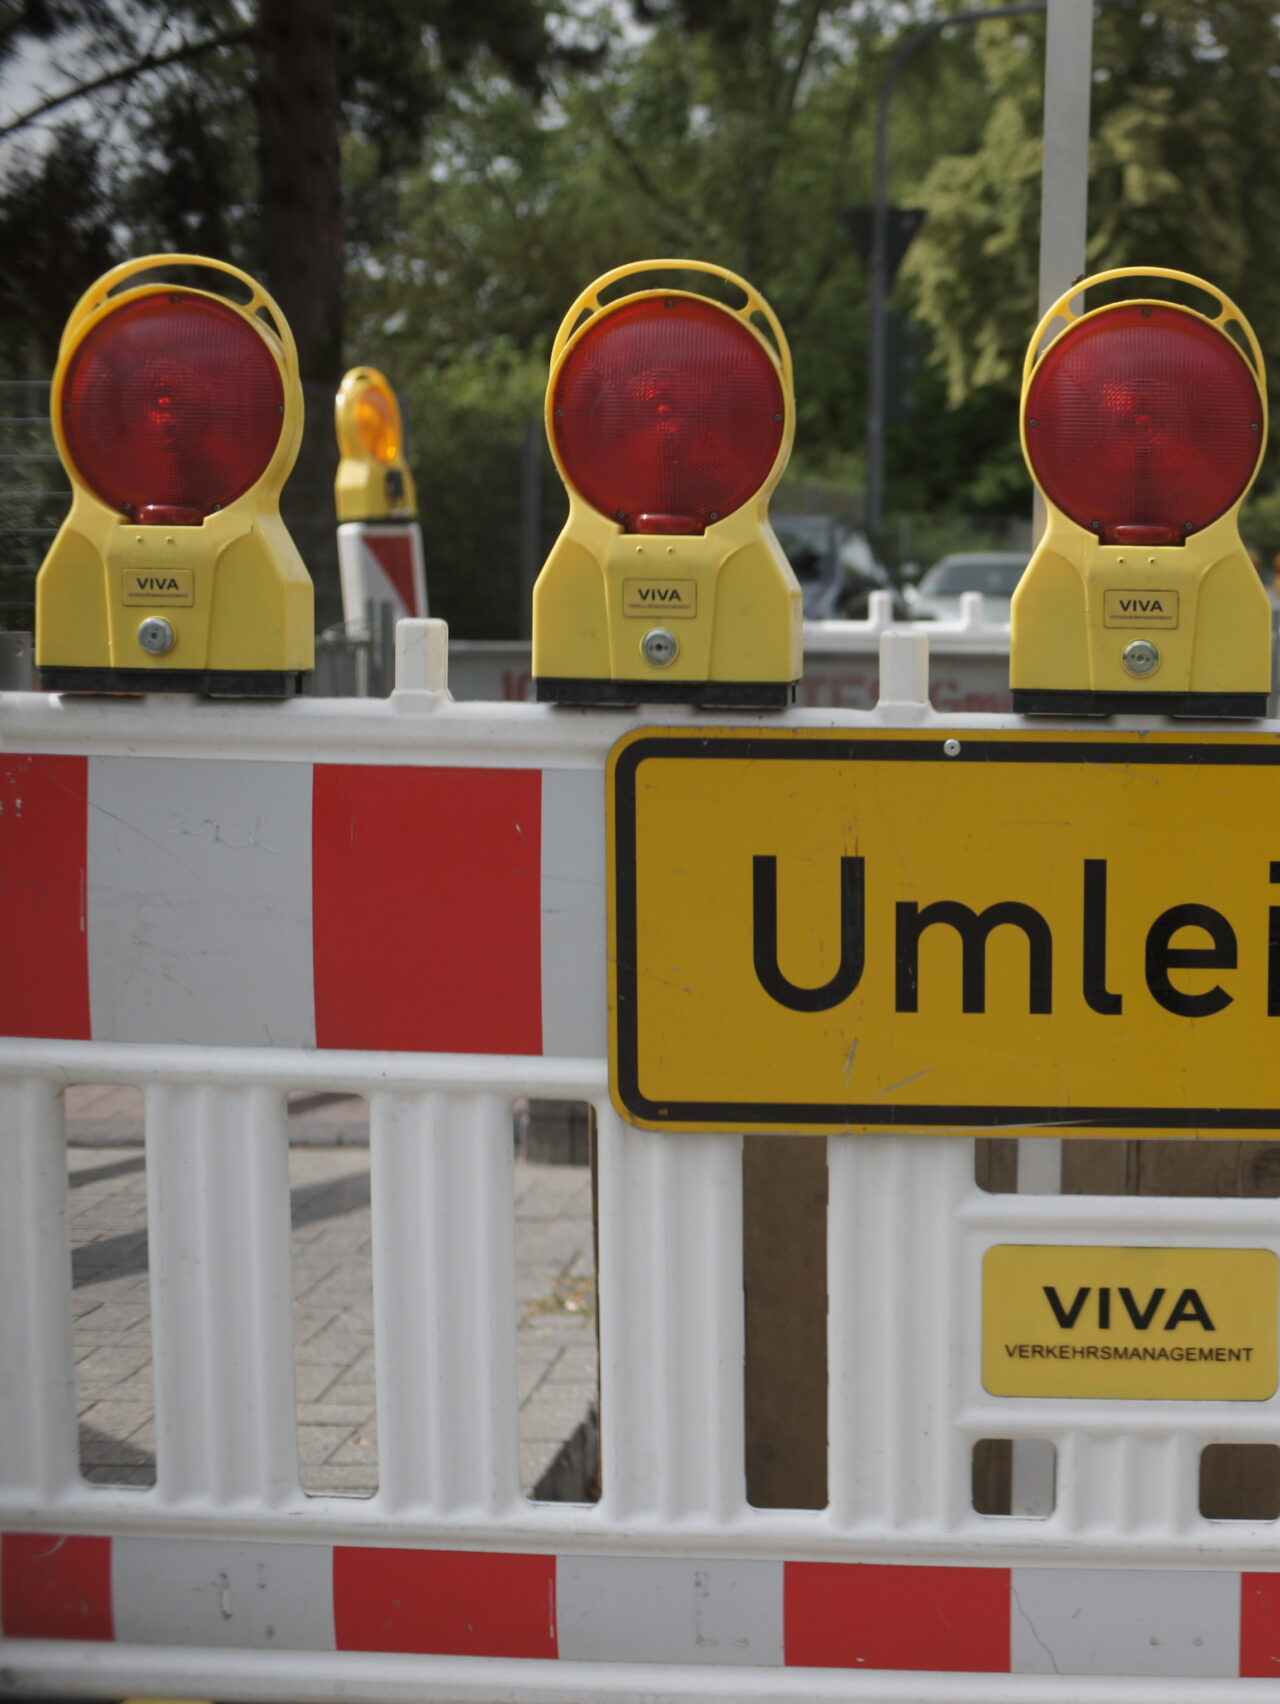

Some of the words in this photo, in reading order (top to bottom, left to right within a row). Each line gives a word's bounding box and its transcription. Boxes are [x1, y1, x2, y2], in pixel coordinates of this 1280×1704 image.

[136, 578, 179, 590] VIVA
[638, 588, 682, 602] VIVA
[1119, 599, 1164, 612] VIVA
[1042, 1286, 1216, 1331] VIVA
[1004, 1344, 1254, 1362] VERKEHRSMANAGEMENT
